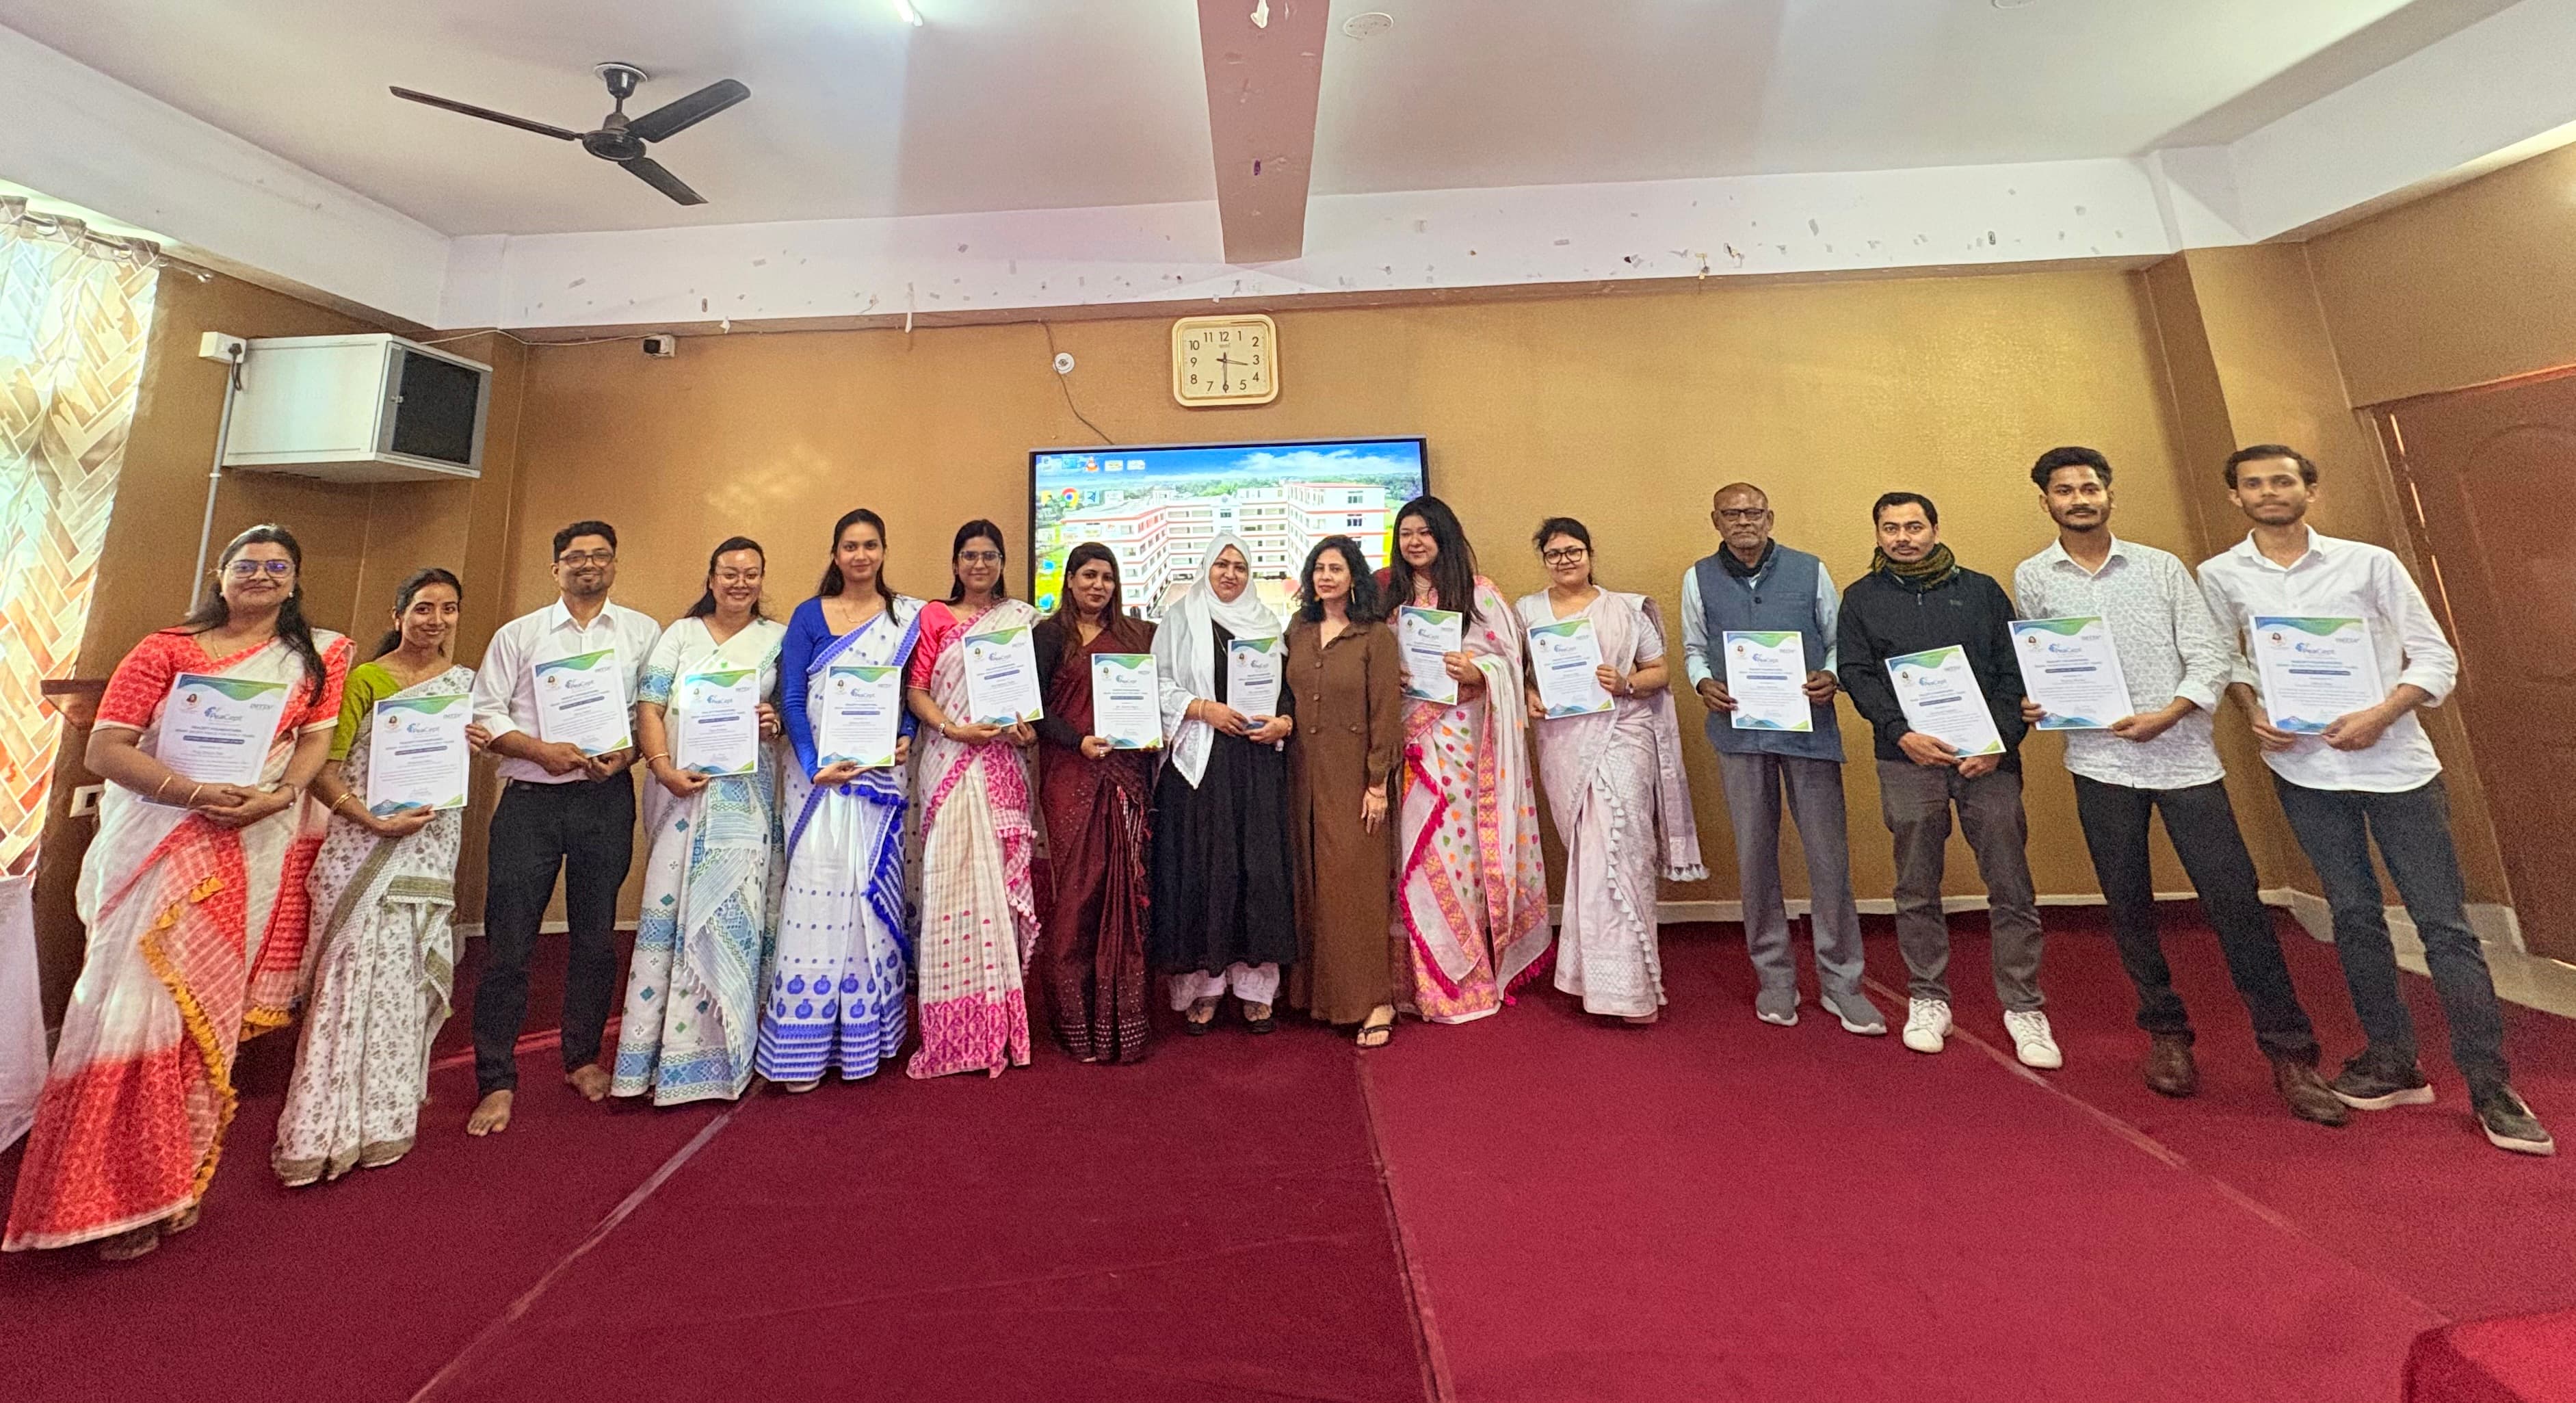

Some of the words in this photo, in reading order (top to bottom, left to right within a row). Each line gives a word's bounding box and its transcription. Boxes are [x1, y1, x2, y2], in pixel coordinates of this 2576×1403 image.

[1204, 332, 1213, 343] 11
[1219, 331, 1229, 342] 12
[1237, 330, 1242, 341] 1
[1189, 340, 1200, 351] 10
[1252, 336, 1260, 348] 2
[1190, 356, 1198, 367] 9
[1252, 354, 1260, 365] 3
[1190, 373, 1198, 384] 8
[1252, 371, 1260, 382] 4
[1207, 380, 1214, 392] 7
[1239, 379, 1247, 391] 5
